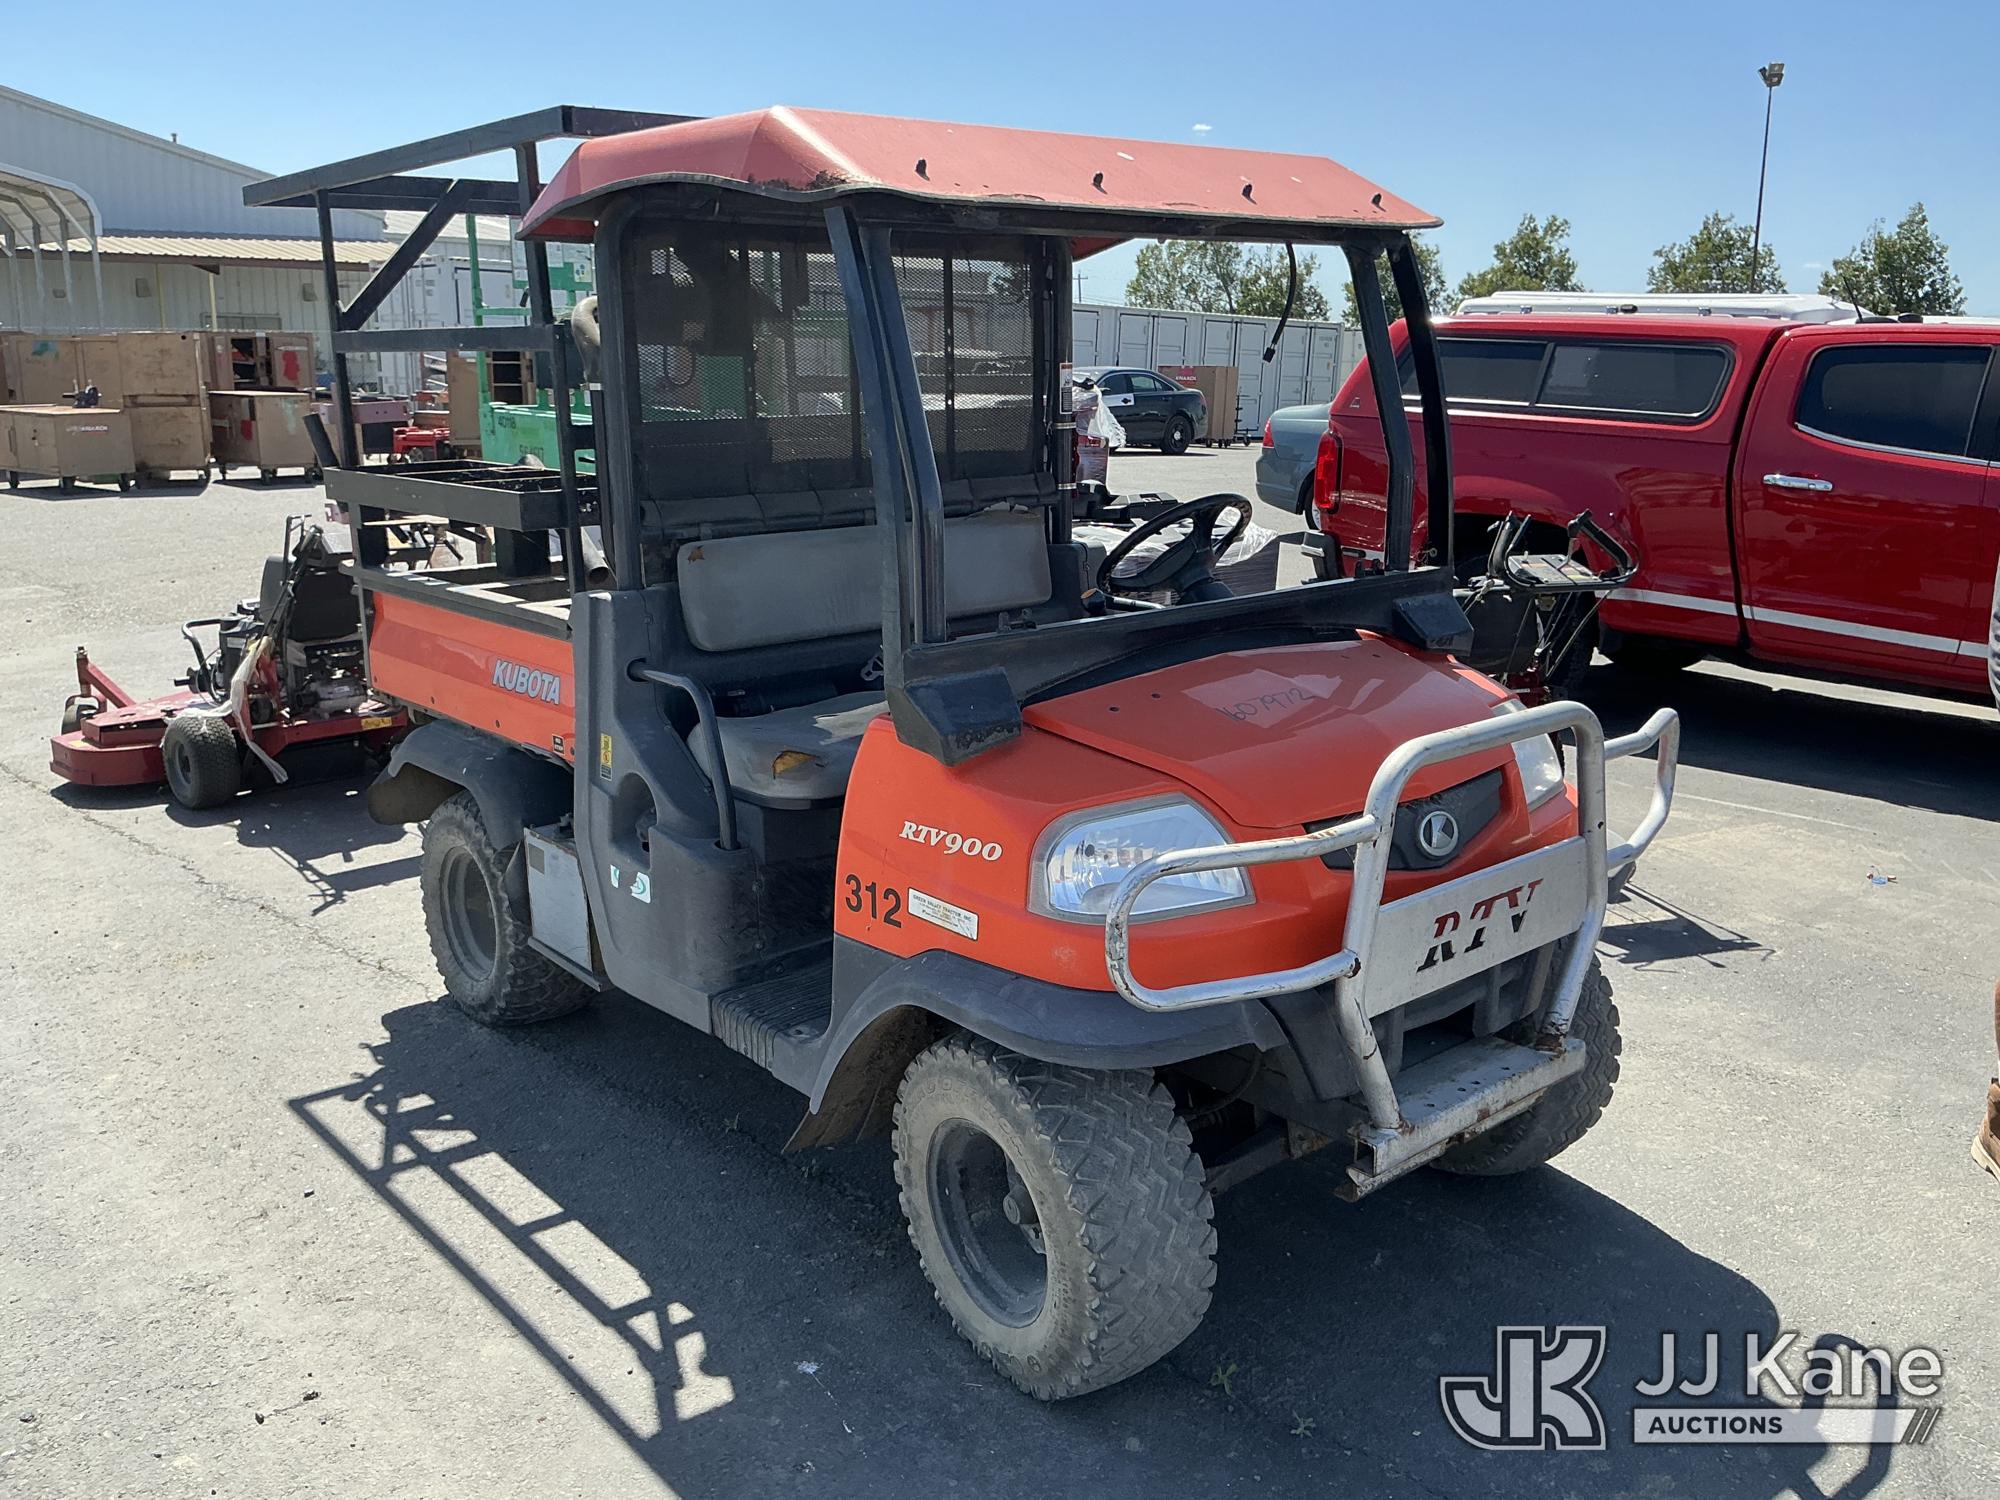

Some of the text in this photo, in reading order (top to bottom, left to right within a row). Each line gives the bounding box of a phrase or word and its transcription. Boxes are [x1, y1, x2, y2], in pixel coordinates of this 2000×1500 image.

[492, 659, 561, 705] KUBOTA
[899, 820, 1003, 862] RTV900
[845, 873, 902, 929] 312
[1416, 878, 1544, 973] RTV
